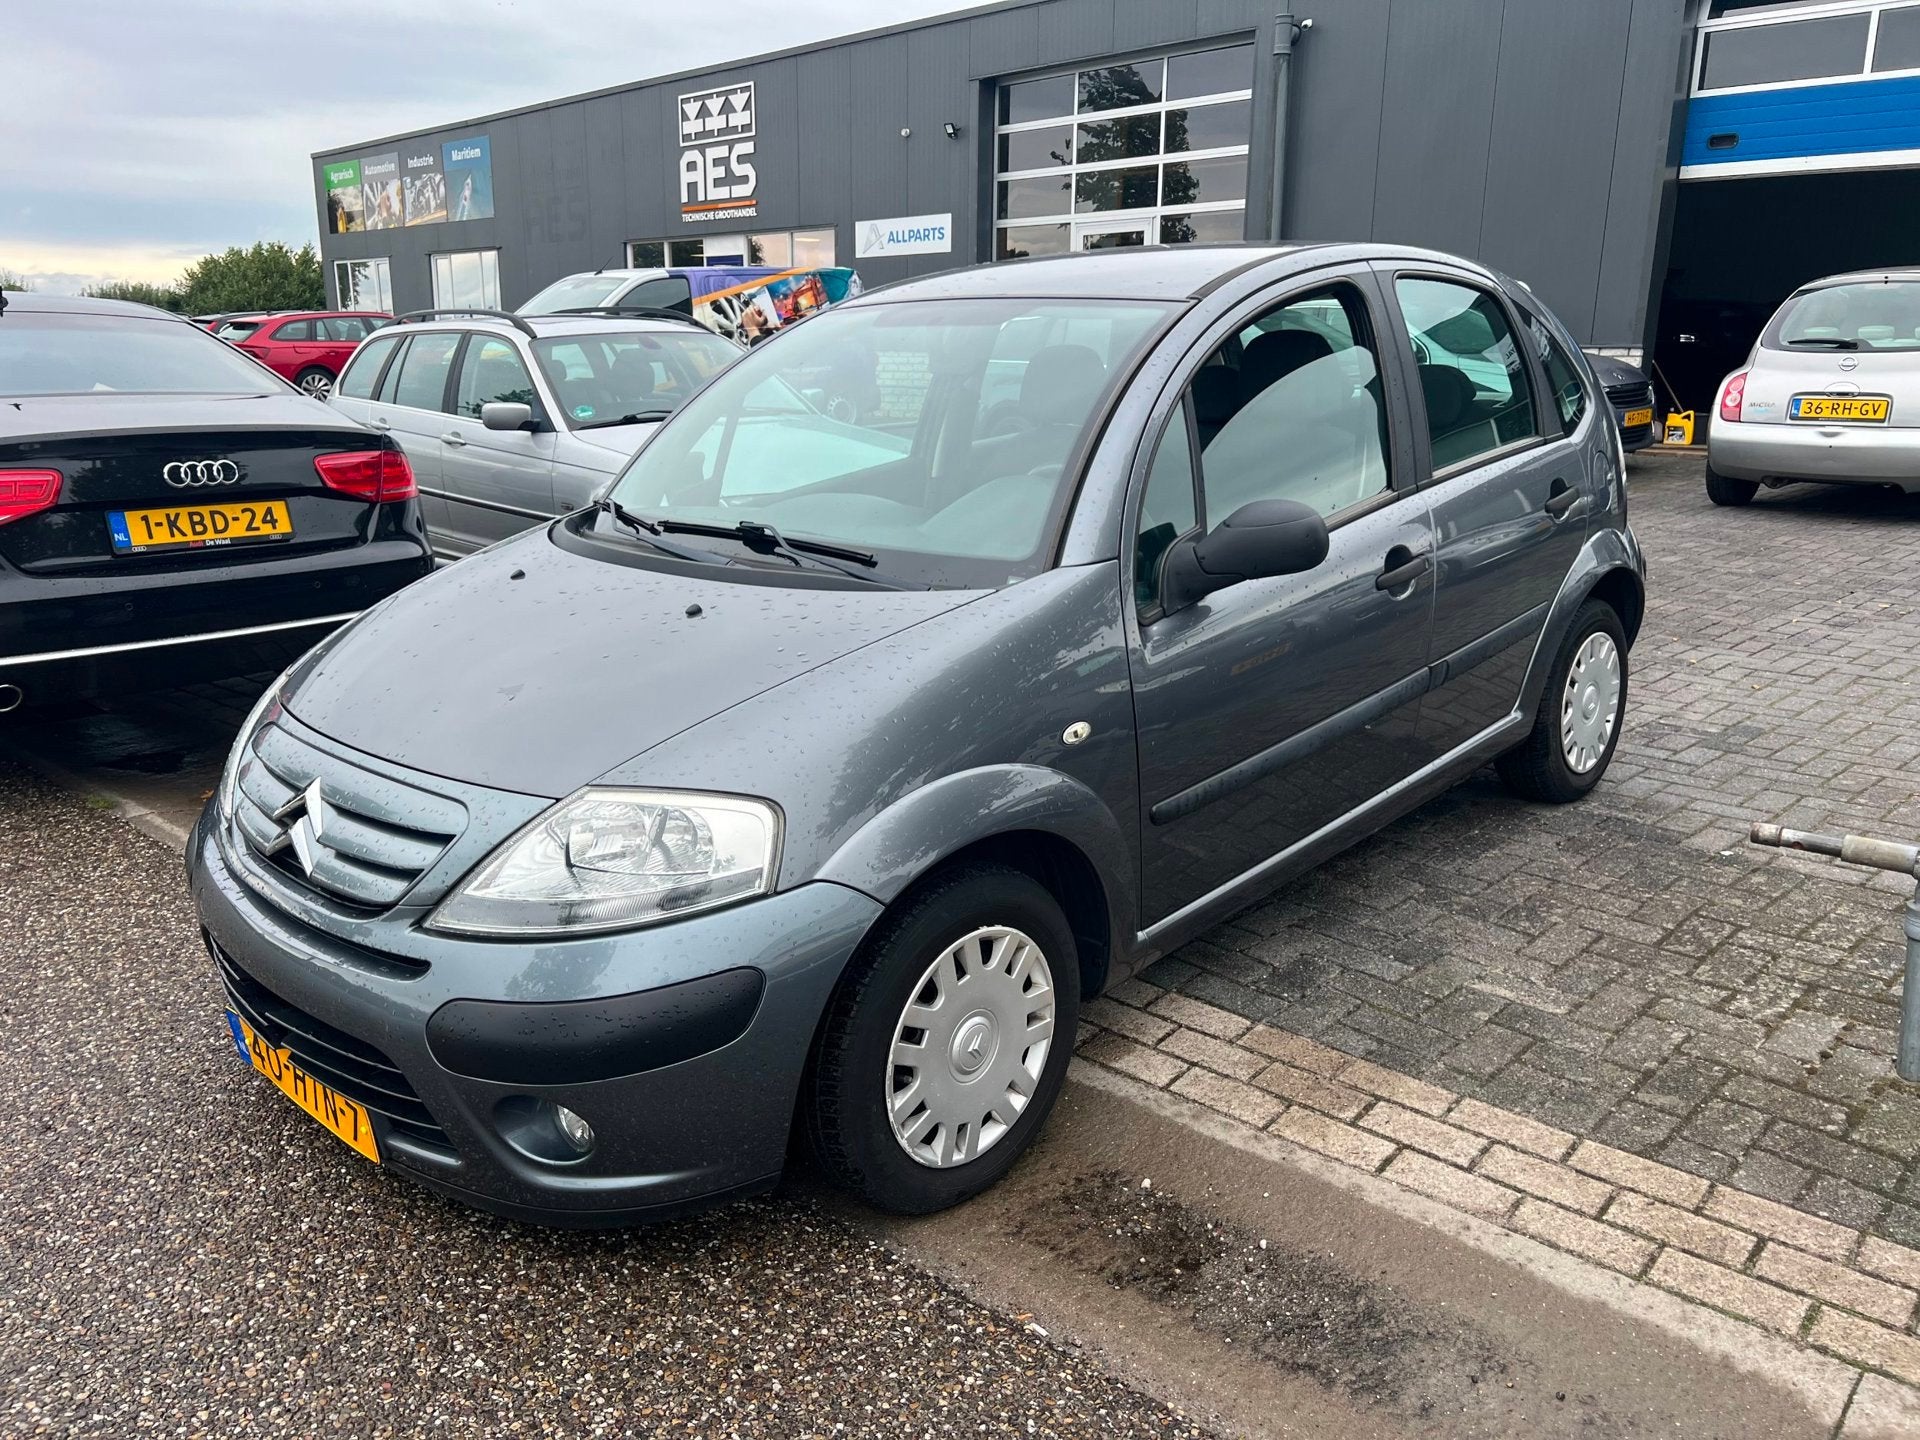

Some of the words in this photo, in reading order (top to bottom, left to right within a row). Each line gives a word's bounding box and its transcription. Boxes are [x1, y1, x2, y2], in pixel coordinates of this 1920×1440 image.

[407, 154, 434, 168] Industrie
[452, 147, 481, 161] Maritiem
[364, 161, 396, 175] Automotive
[680, 141, 757, 204] AES
[330, 168, 354, 183] Agrarisch
[682, 211, 715, 222] TECHNISCHE
[715, 207, 757, 220] GROOTHANDEL
[887, 227, 945, 244] ALLPARTS
[1803, 402, 1882, 416] 36-RH-GV
[140, 506, 279, 540] 1-KBD-24
[114, 532, 129, 542] NL
